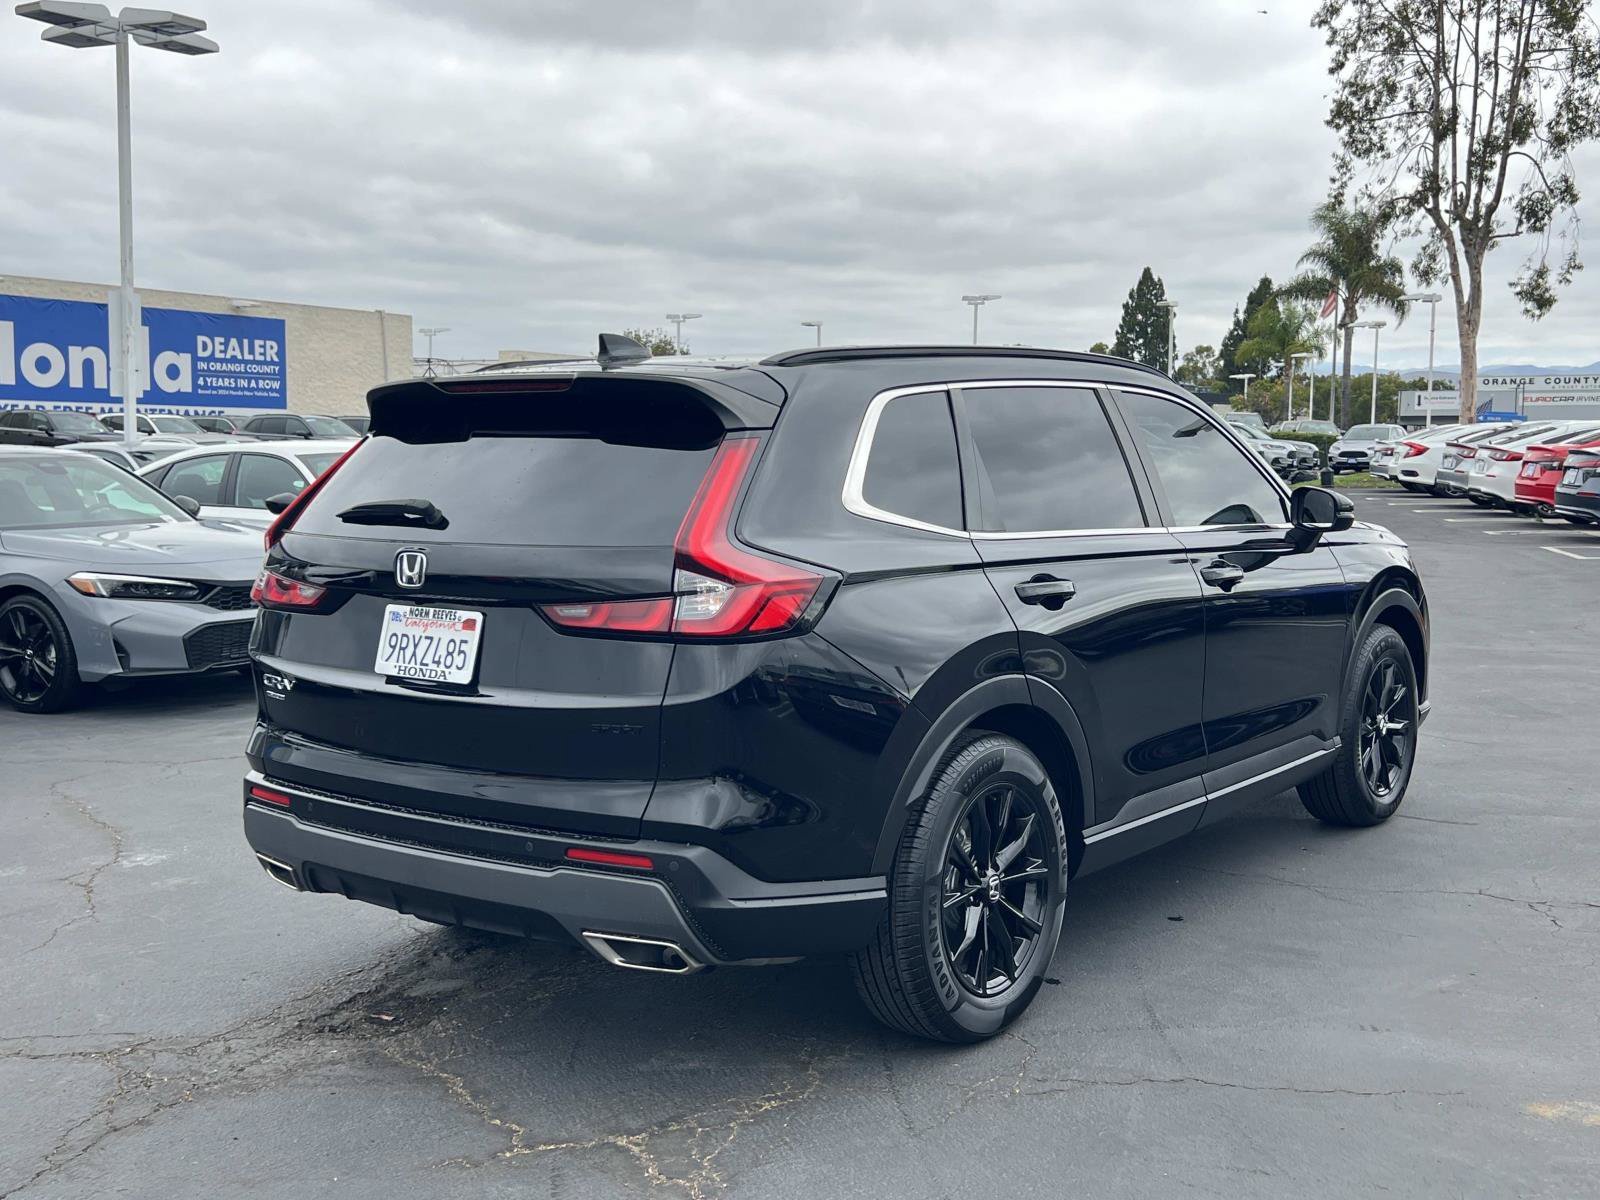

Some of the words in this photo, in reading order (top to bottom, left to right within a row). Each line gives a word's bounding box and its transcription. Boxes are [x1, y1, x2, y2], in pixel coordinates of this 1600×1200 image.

[197, 335, 280, 362] DEALER
[0, 320, 192, 393] ona
[198, 362, 207, 370] IN
[209, 362, 246, 372] ORANGE
[246, 364, 280, 374] COUNTY
[198, 377, 205, 386] 4
[205, 377, 236, 388] YEARS
[237, 379, 248, 388] IN
[250, 379, 258, 389] A
[258, 380, 280, 390] ROW
[1483, 377, 1535, 385] ORANGE
[1544, 376, 1600, 385] COUNTY
[408, 608, 430, 618] NORM
[432, 609, 458, 620] REEVES
[385, 632, 469, 671] 9RXZ485
[397, 665, 448, 680] HONDA
